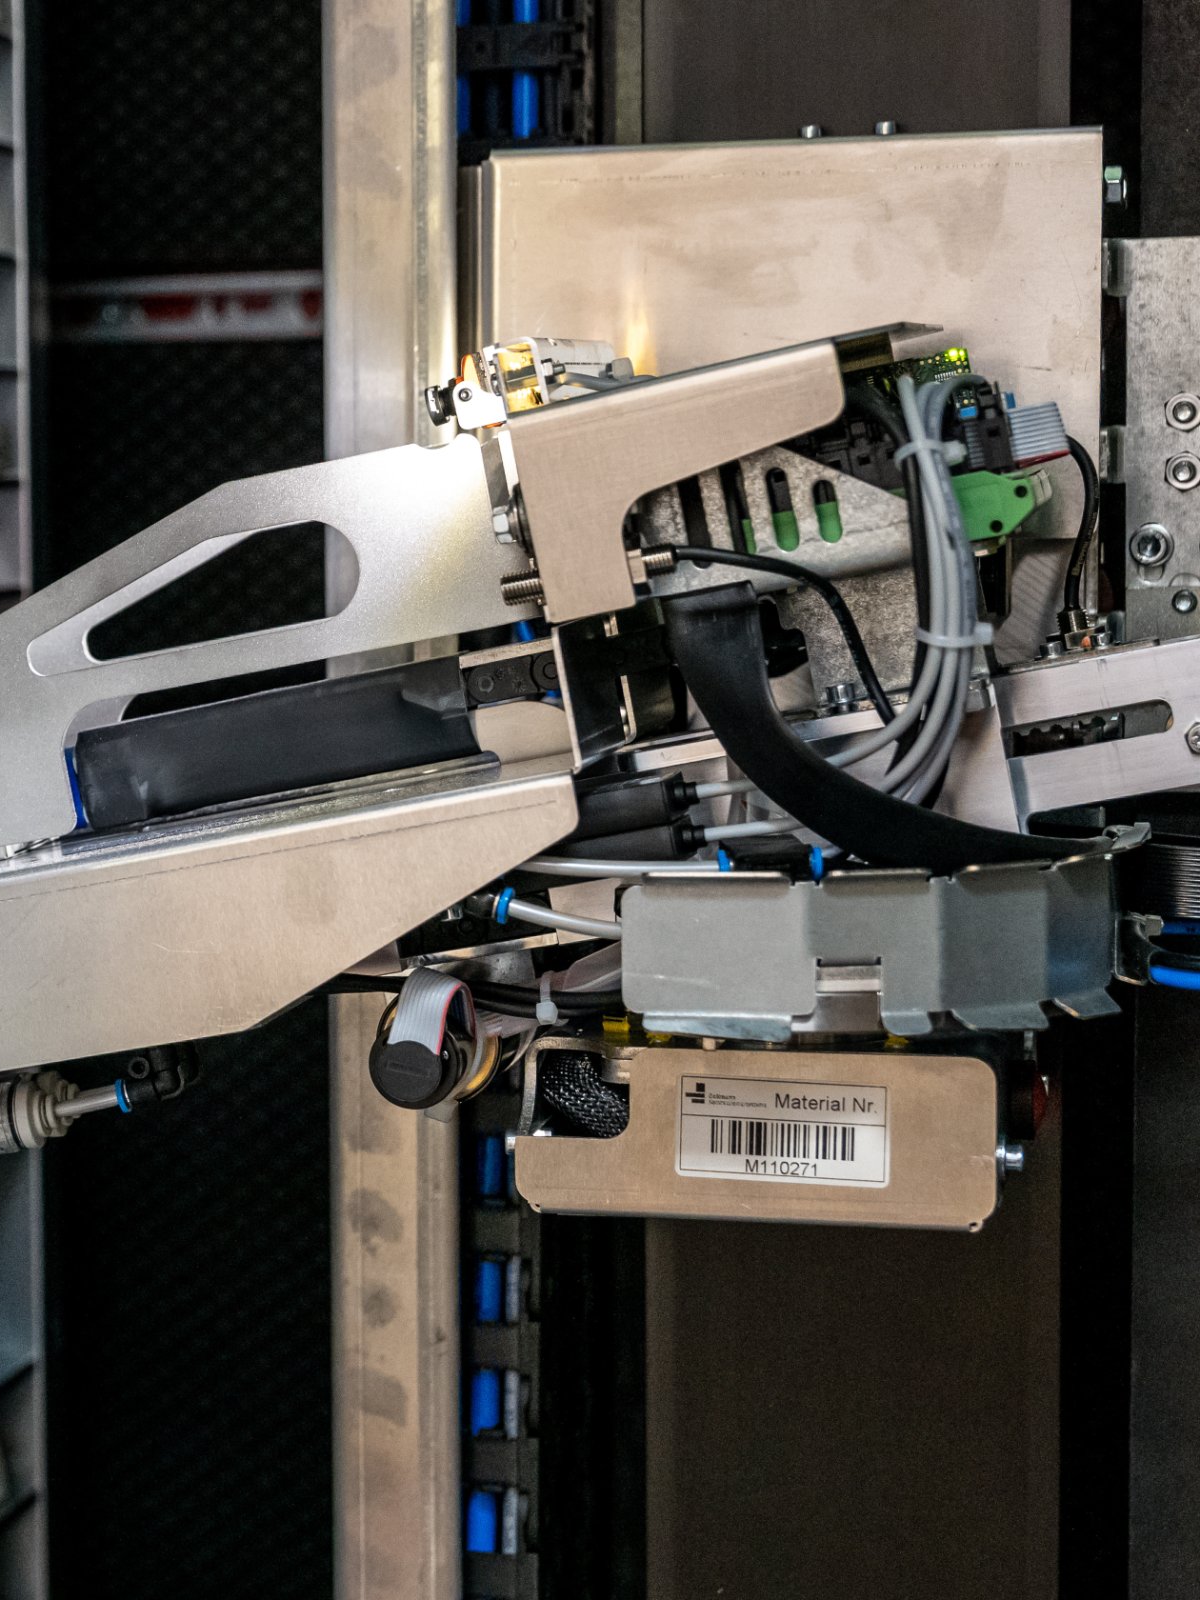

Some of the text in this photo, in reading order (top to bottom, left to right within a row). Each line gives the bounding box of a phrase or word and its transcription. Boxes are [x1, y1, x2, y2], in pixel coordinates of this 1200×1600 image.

[775, 1093, 845, 1112] Material
[852, 1098, 878, 1114] Nr.
[745, 1158, 818, 1177] M110271
